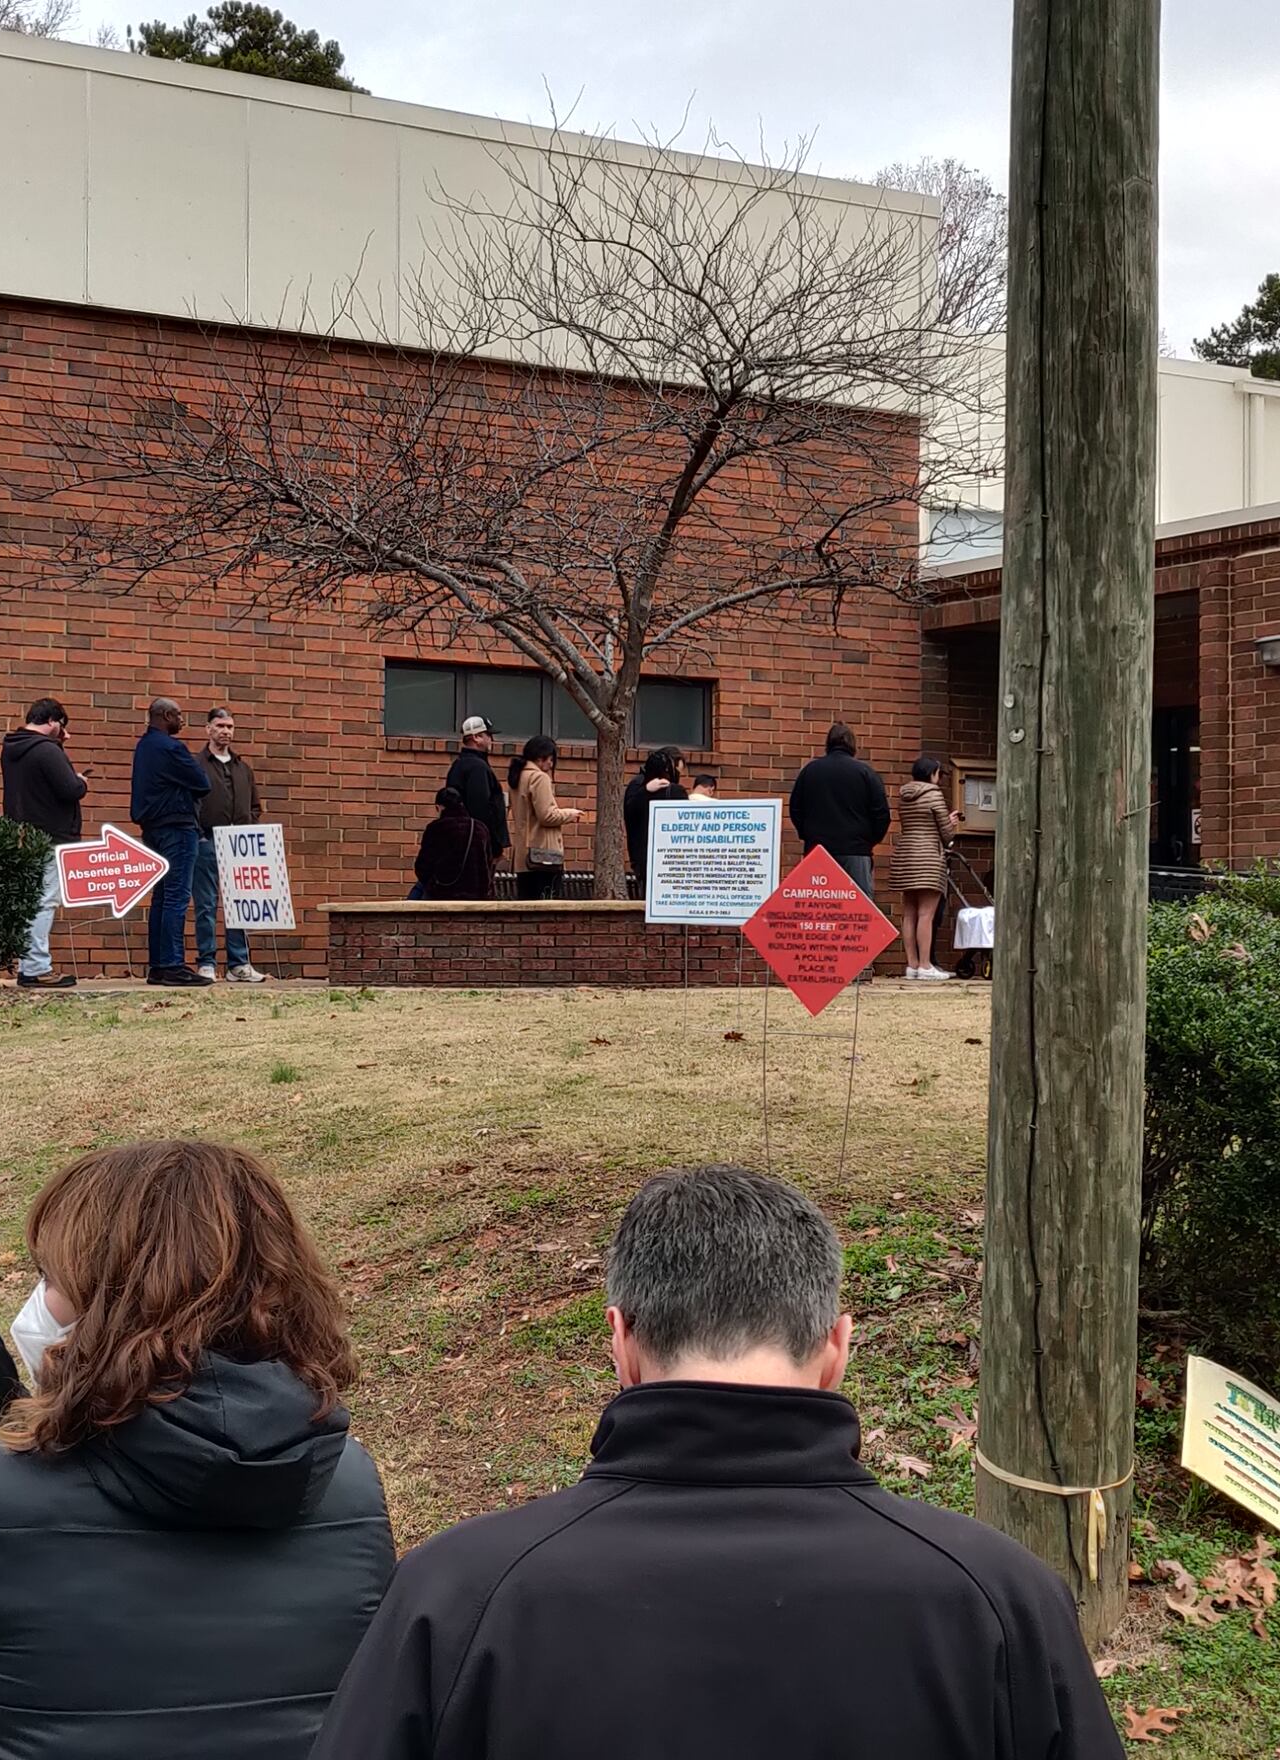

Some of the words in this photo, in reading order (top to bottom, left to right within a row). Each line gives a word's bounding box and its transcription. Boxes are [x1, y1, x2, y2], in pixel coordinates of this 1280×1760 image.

[677, 810, 711, 821] VOTING
[713, 810, 750, 820] NOTICE:
[661, 823, 699, 833] ELDERLY
[701, 823, 721, 832] AND
[723, 822, 767, 832] PERSONS
[228, 833, 267, 857] VOTE
[671, 835, 695, 845] WITH
[697, 834, 756, 845] DISABILITIES
[88, 850, 129, 864] Official
[67, 866, 121, 881] Absentee
[123, 862, 157, 874] Ballot
[233, 866, 272, 890] HERE
[812, 876, 828, 886] NO
[87, 881, 116, 893] Drop
[118, 878, 141, 889] Box
[782, 888, 857, 900] CAMPAIGNING
[233, 899, 279, 922] TODAY
[800, 922, 813, 930] 150
[815, 922, 836, 931] FEET
[839, 923, 849, 931] OF
[853, 924, 869, 932] THE
[775, 932, 804, 940] OUTER
[805, 932, 829, 941] EDGE
[831, 933, 841, 941] OF
[844, 934, 862, 942] ANY
[768, 943, 806, 951] BUILDING
[802, 954, 838, 962] POLLING
